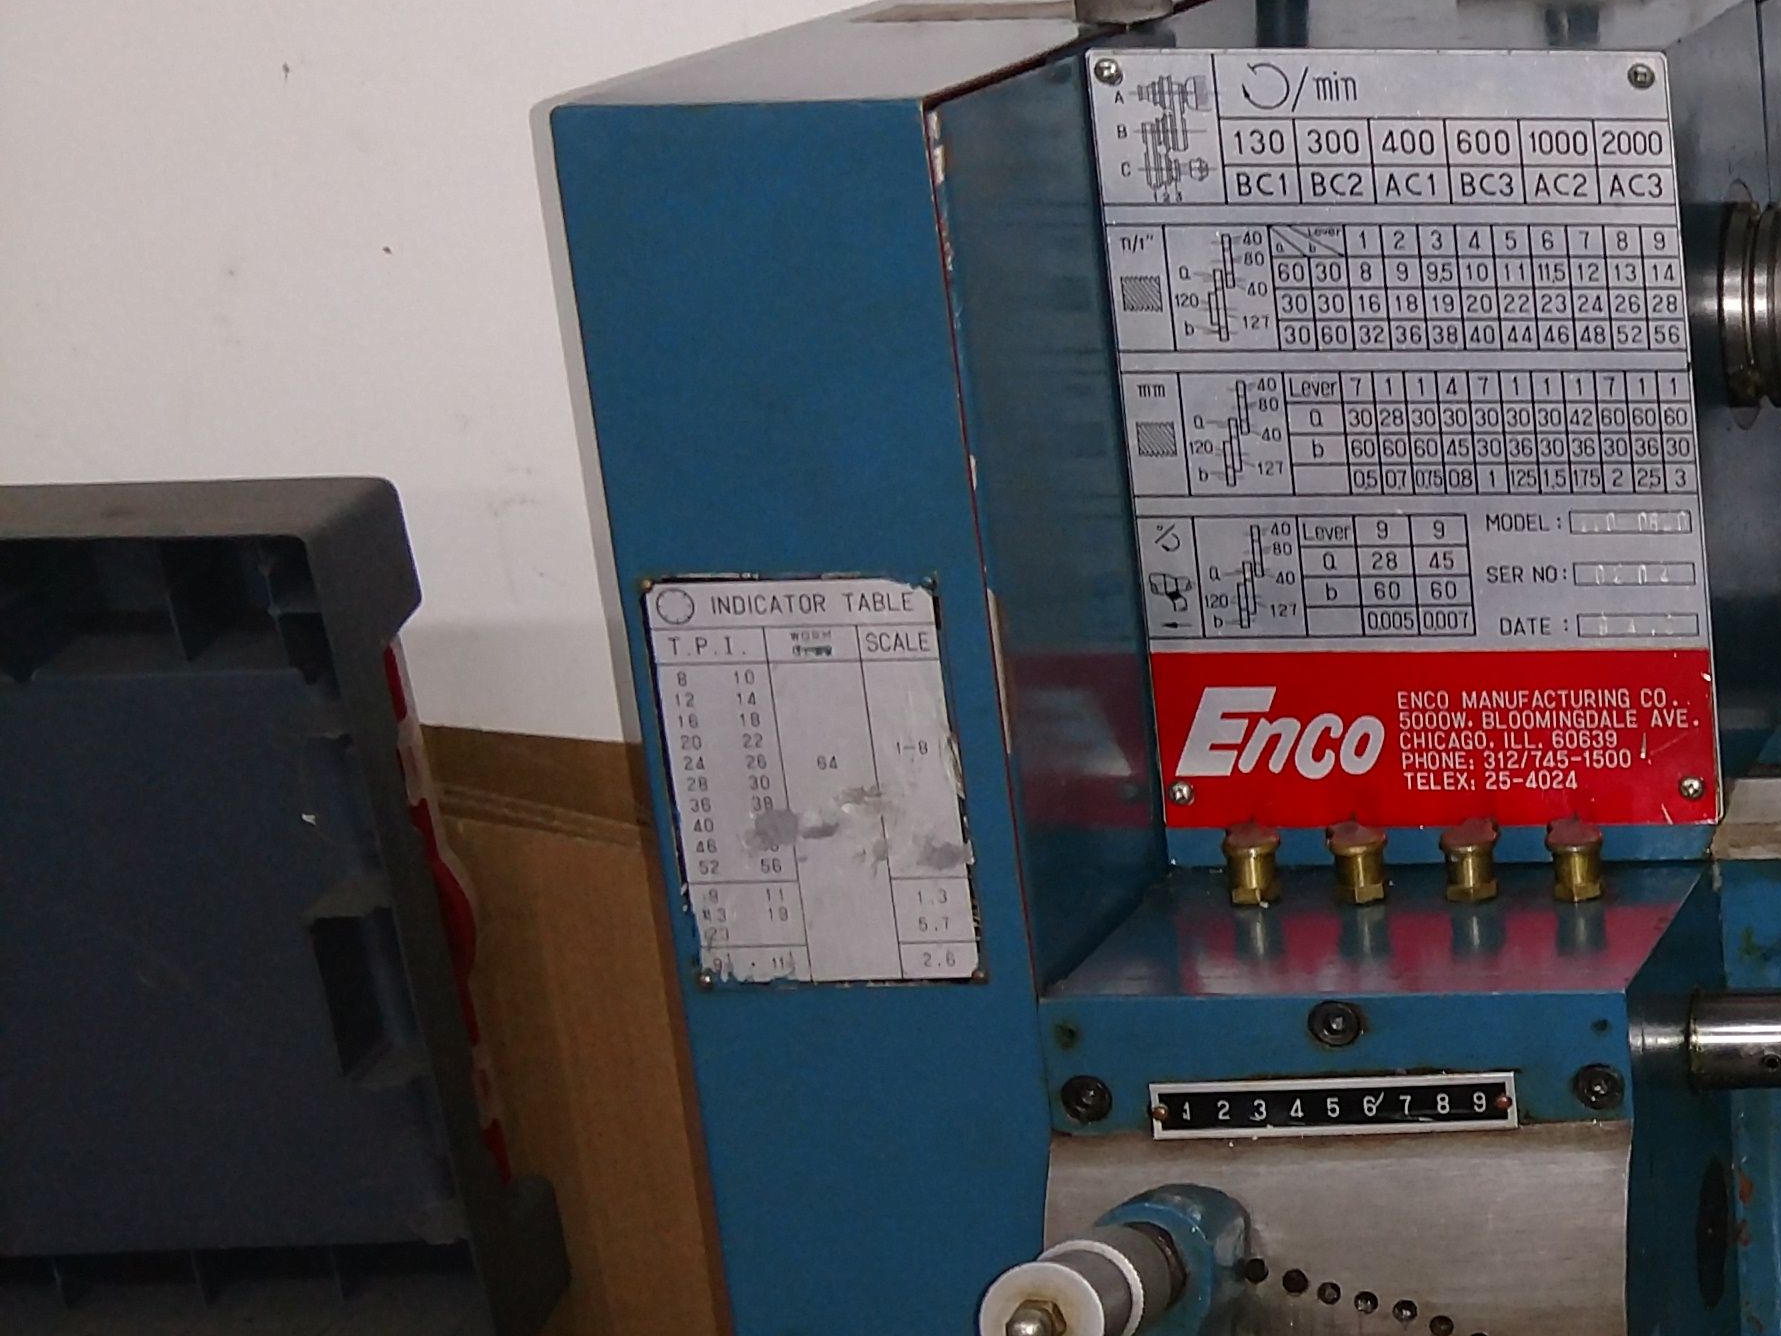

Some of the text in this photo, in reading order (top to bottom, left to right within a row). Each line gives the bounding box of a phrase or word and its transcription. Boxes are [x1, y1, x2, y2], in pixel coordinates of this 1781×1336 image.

[1114, 91, 1125, 105] A
[1117, 125, 1128, 139] B
[1233, 129, 1663, 155] 130 300 400 600 1000 2000
[1236, 172, 1663, 197] BC1 BC2 AC1 BC3 AC2 AC3
[1359, 230, 1665, 250] 1 2 3 4 5 6 7 8 9
[1277, 263, 1675, 282] 60 30 8 9 10 11 12 13 14
[1281, 294, 1677, 313] 30 30 16 18 19 20 22 23 24 26 28
[1284, 325, 1680, 344] 30 60 32 36 38 40 44 46 48 52 56
[1289, 377, 1337, 398] Lever
[1312, 439, 1324, 459] b
[1302, 520, 1445, 541] Lever 9 9
[1372, 551, 1398, 571] 28
[1429, 551, 1454, 571] 45
[1486, 566, 1523, 583] SER
[1374, 581, 1400, 601] 60
[1431, 581, 1456, 600] 60
[711, 592, 915, 614] INDICATOR TABLE
[865, 631, 931, 653] SCALE
[734, 670, 755, 685] 10
[675, 692, 756, 707] 12 14
[1398, 691, 1449, 710] ENCO
[1461, 689, 1632, 710] MANUFACTURING
[1482, 709, 1638, 730] BLOOMINGDALE
[1650, 709, 1699, 729] AVE.
[680, 734, 763, 750] 20 22
[1174, 686, 1385, 780] Enco
[1503, 731, 1542, 750] ILL.
[1552, 730, 1618, 749] 60639
[684, 757, 705, 771] 24
[1402, 749, 1632, 770] PHONE: 312/745-1500
[749, 775, 770, 790] 30
[1403, 770, 1578, 791] TELEX: 25-4024
[693, 819, 714, 833] 40
[1182, 1091, 1487, 1121] 1 2 3 4 5 6 7 8 9
